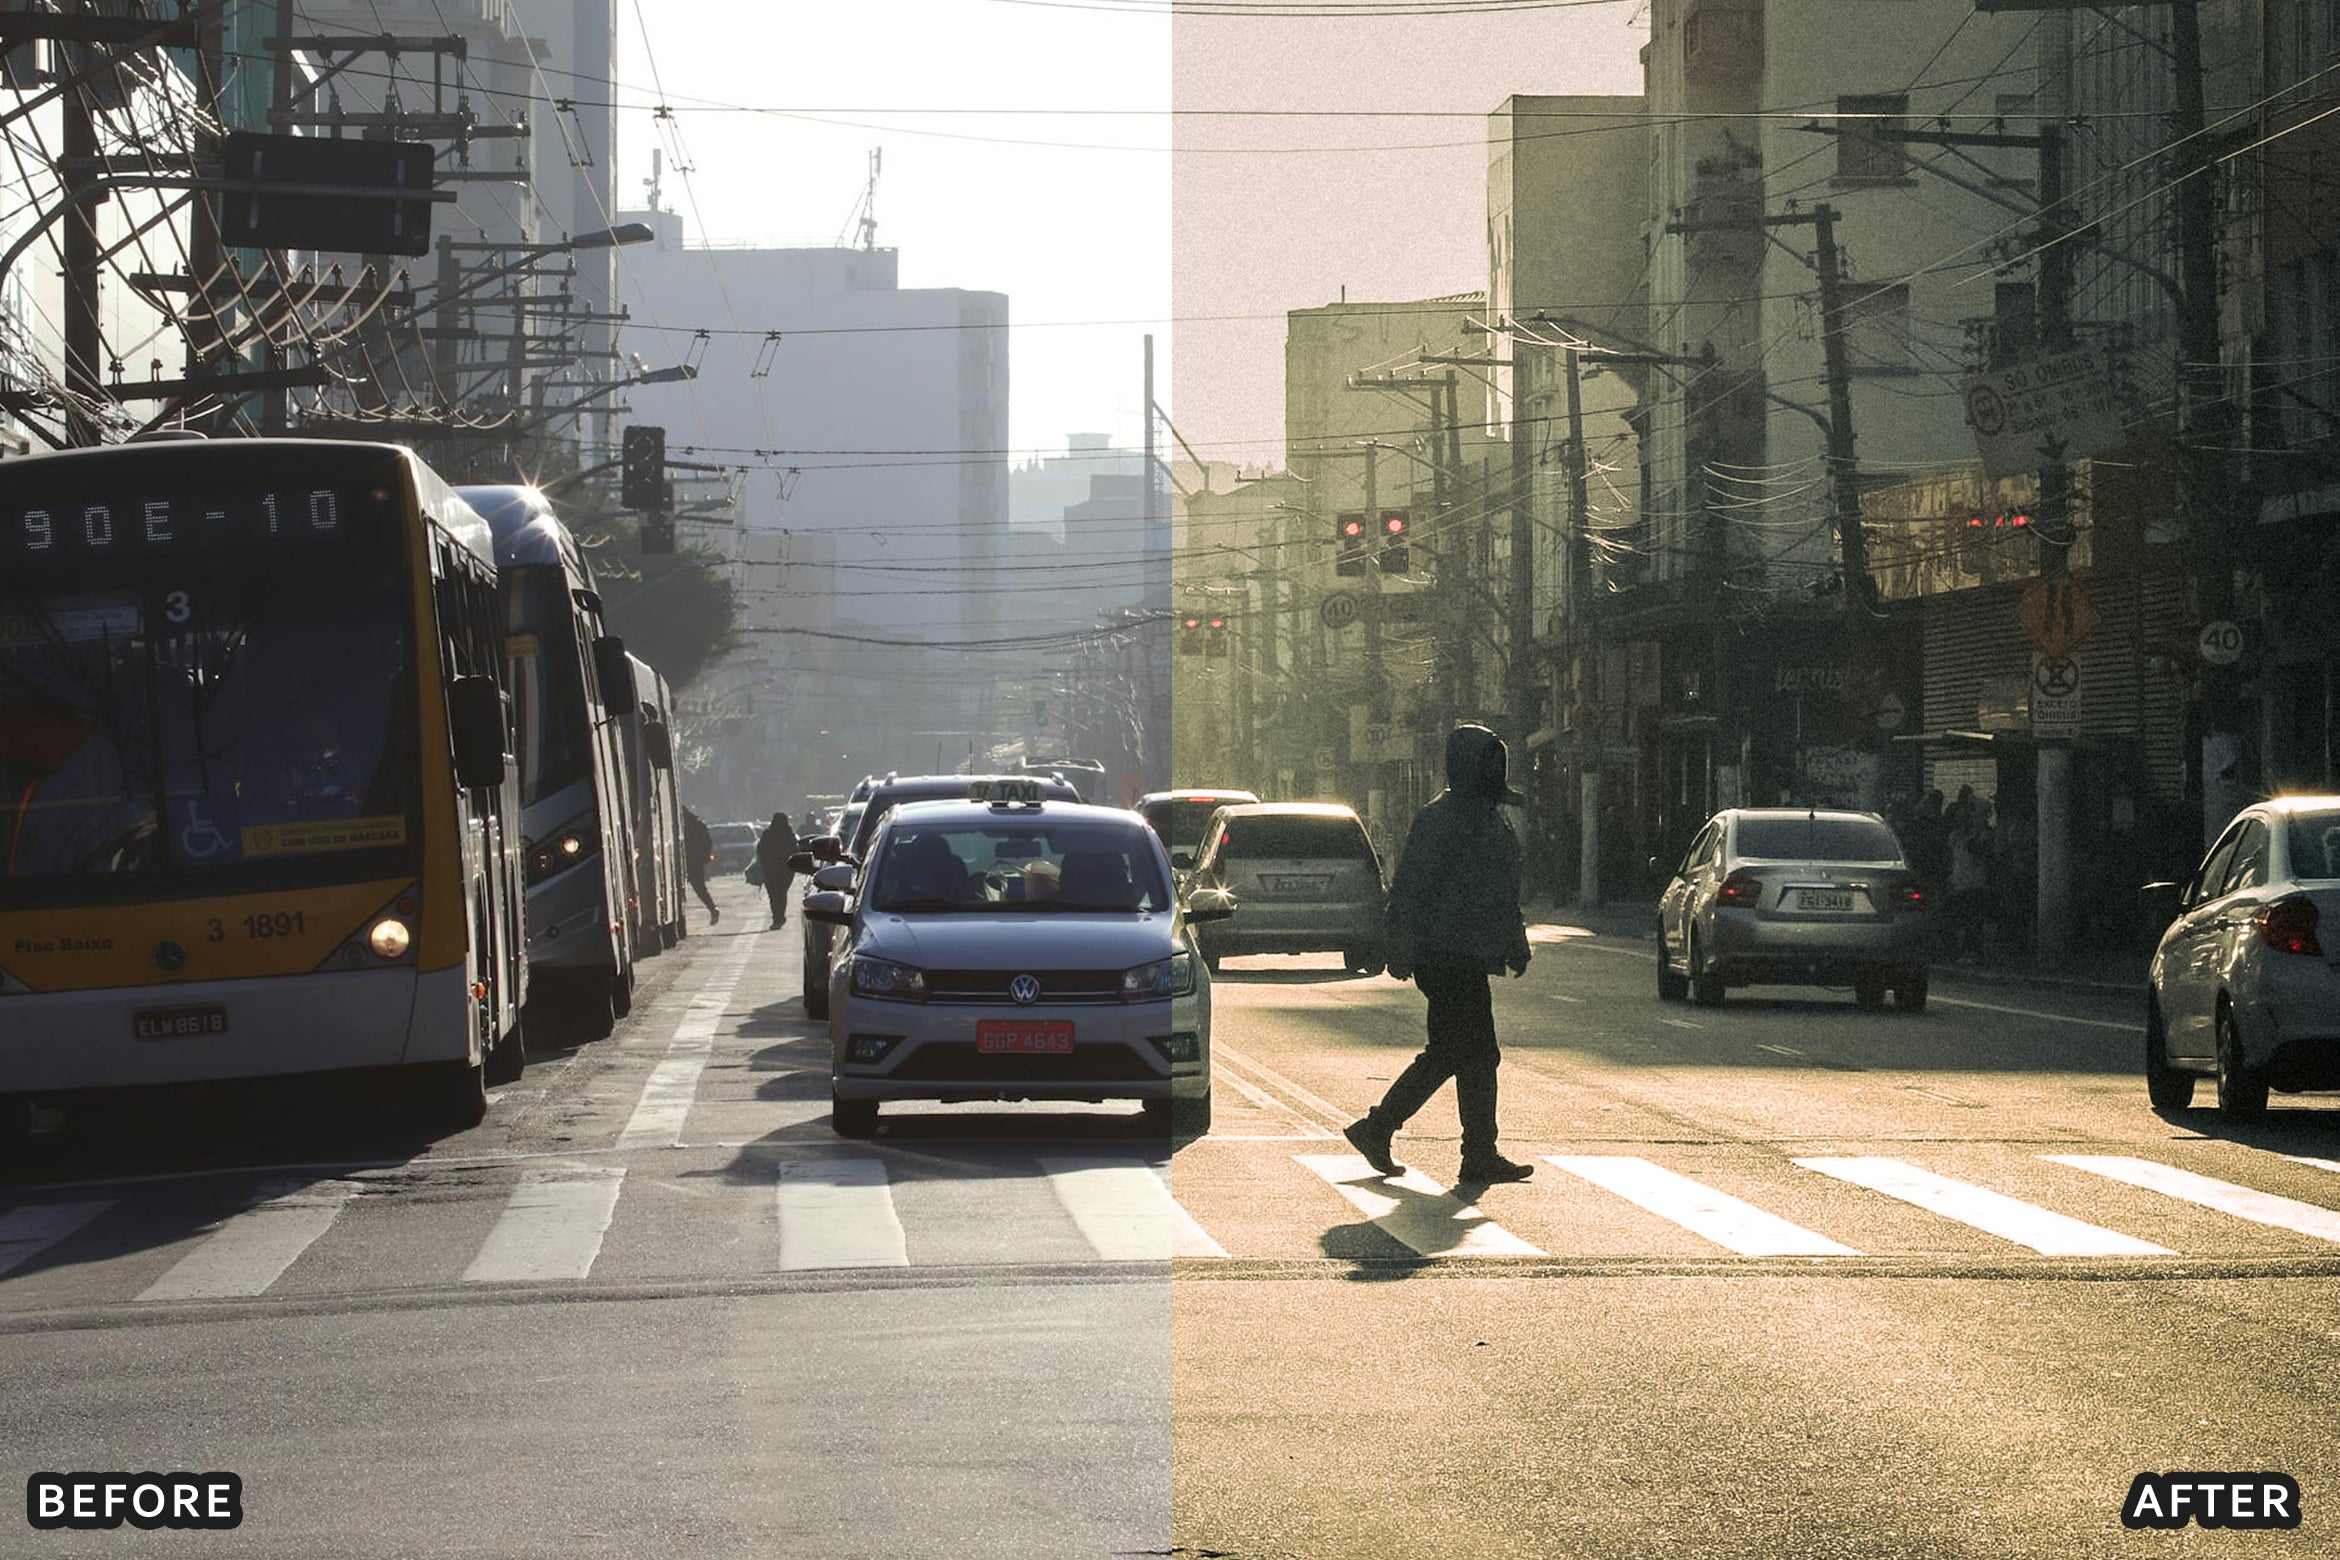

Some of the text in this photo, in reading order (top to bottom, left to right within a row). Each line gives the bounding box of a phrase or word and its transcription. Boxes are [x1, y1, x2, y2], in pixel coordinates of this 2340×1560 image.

[166, 591, 190, 622] 3
[2204, 627, 2240, 651] 40
[999, 783, 1038, 801] TAXI
[281, 836, 304, 848] COM
[307, 835, 331, 847] USO
[333, 834, 347, 845] DE
[207, 911, 306, 943] 3 1891
[14, 937, 113, 953] Piso Baixo
